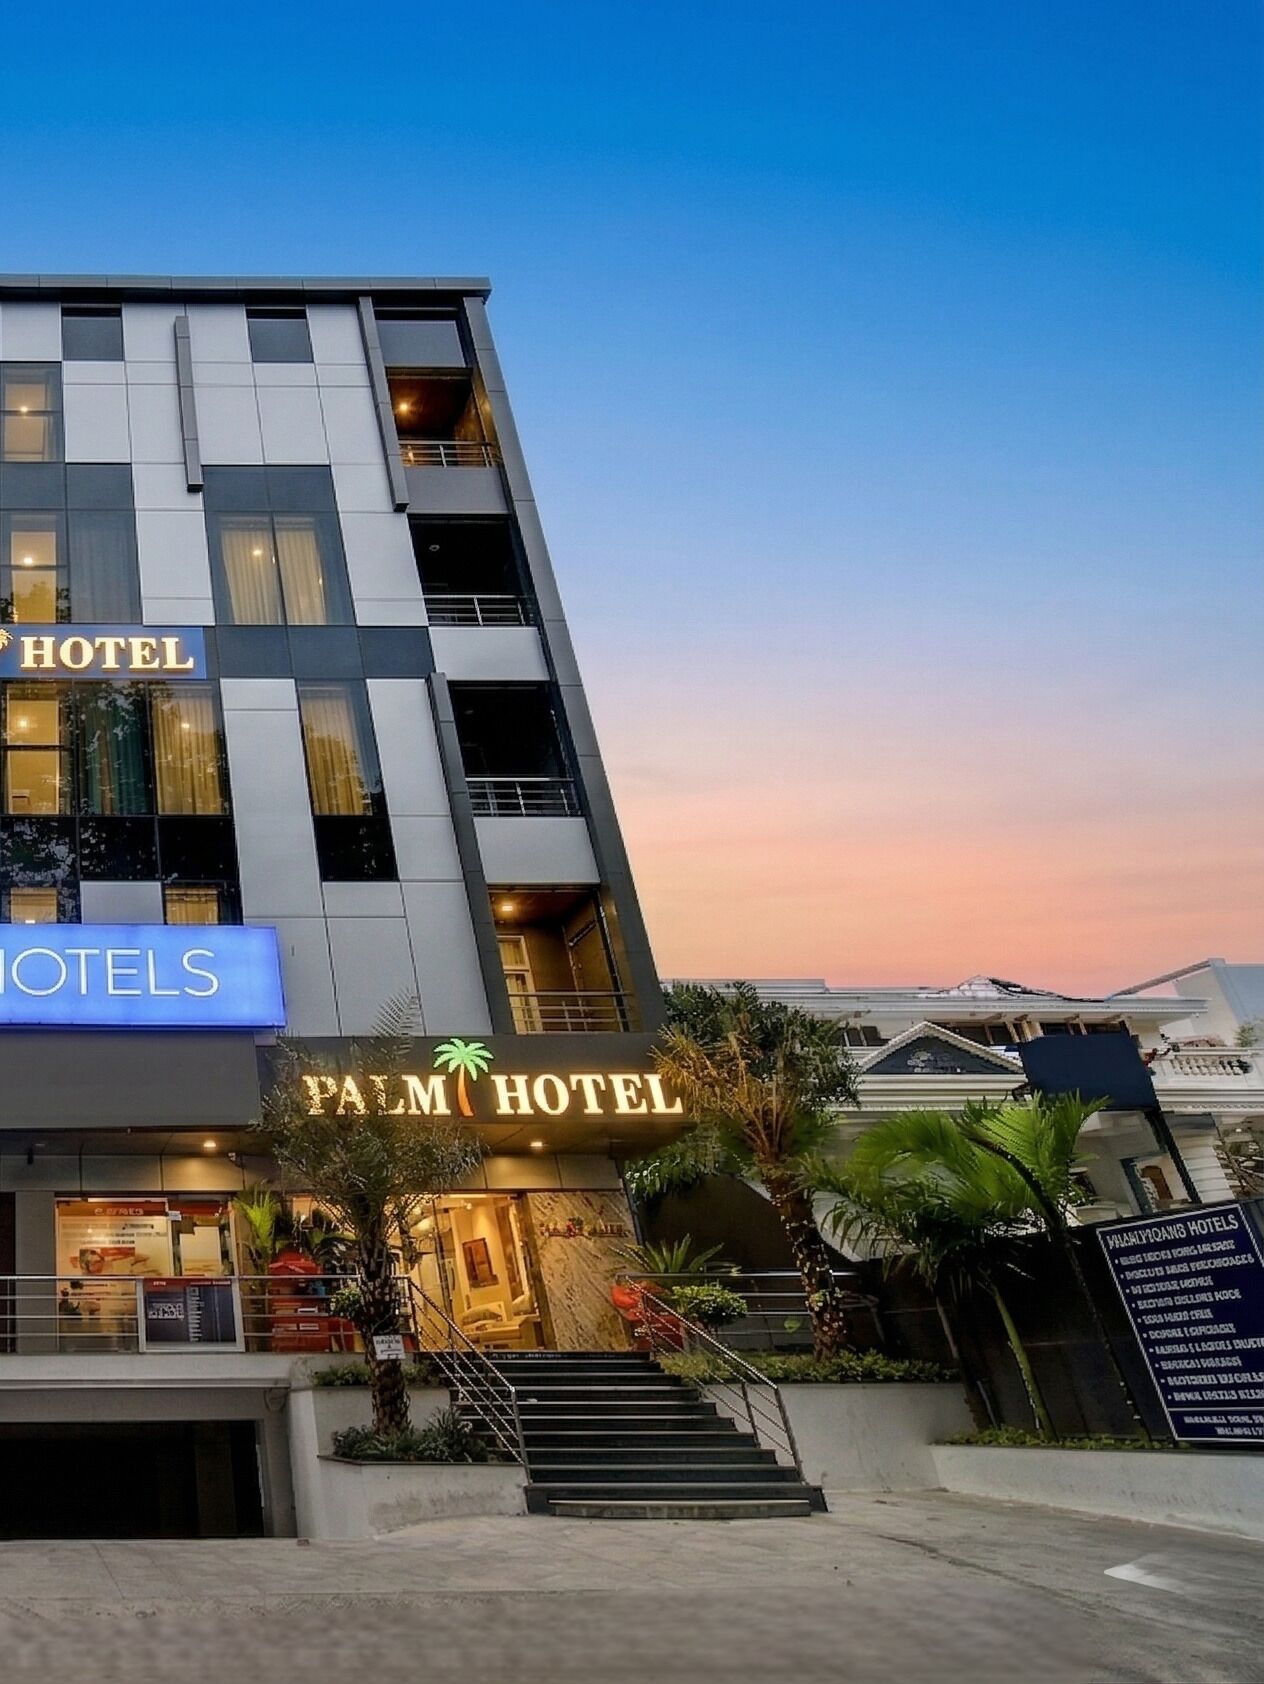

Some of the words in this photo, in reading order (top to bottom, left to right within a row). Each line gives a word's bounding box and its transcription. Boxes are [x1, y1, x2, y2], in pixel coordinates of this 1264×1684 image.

[19, 636, 195, 671] HOTEL
[302, 1073, 451, 1116] PALM
[490, 1072, 685, 1116] HOTEL
[1186, 1213, 1239, 1238] HOTELS
